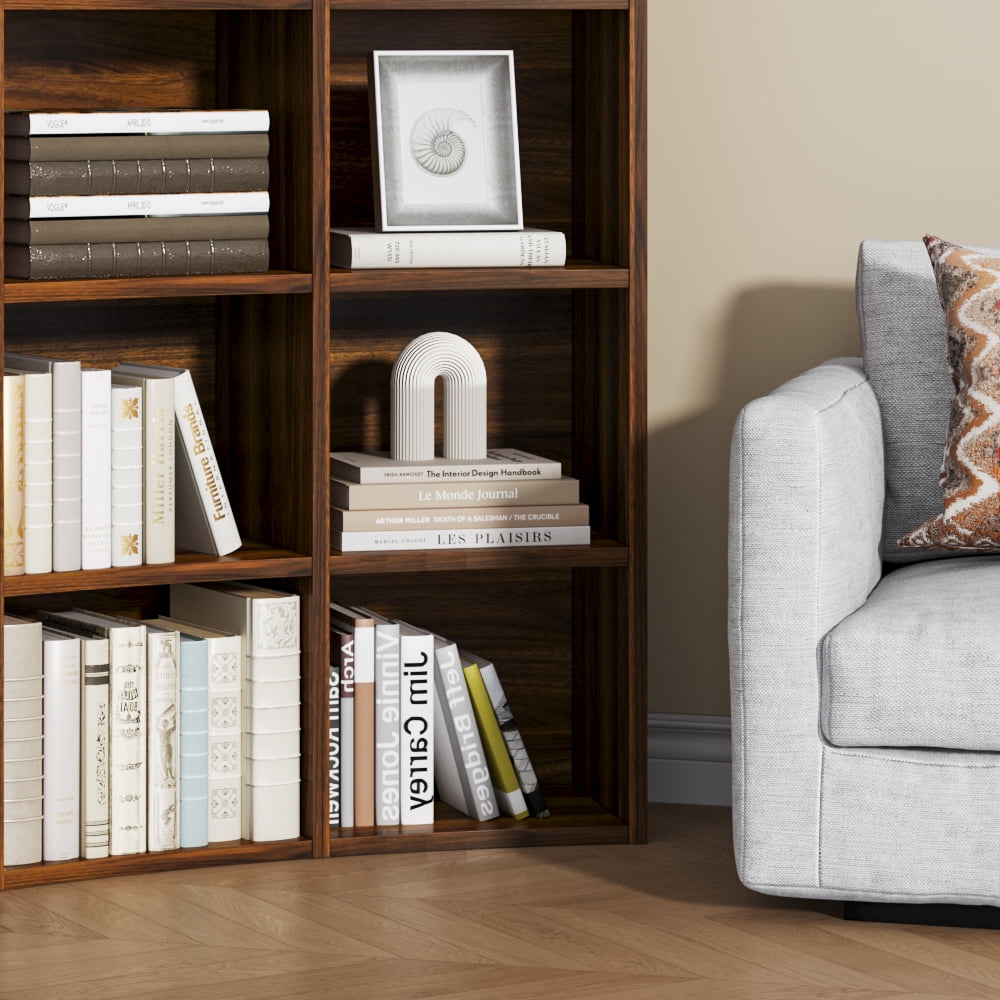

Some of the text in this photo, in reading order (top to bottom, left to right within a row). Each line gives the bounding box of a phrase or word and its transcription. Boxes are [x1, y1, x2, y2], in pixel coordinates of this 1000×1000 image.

[183, 403, 226, 522] Furniture Brands
[426, 470, 441, 478] The
[442, 469, 471, 478] Interior
[471, 469, 499, 479] Design
[500, 467, 541, 477] Handbook
[151, 472, 165, 526] Miller
[418, 487, 518, 501] Le Monde Journal
[375, 517, 404, 525] ARTHUR
[405, 516, 430, 524] MILLER
[433, 515, 456, 524] DEATH
[457, 515, 466, 523] OF
[473, 514, 508, 523] SALESMAN
[514, 513, 526, 521] THE
[527, 513, 560, 521] CRUCIBLE
[437, 534, 466, 545] LES
[475, 531, 552, 544] PLAISIRS
